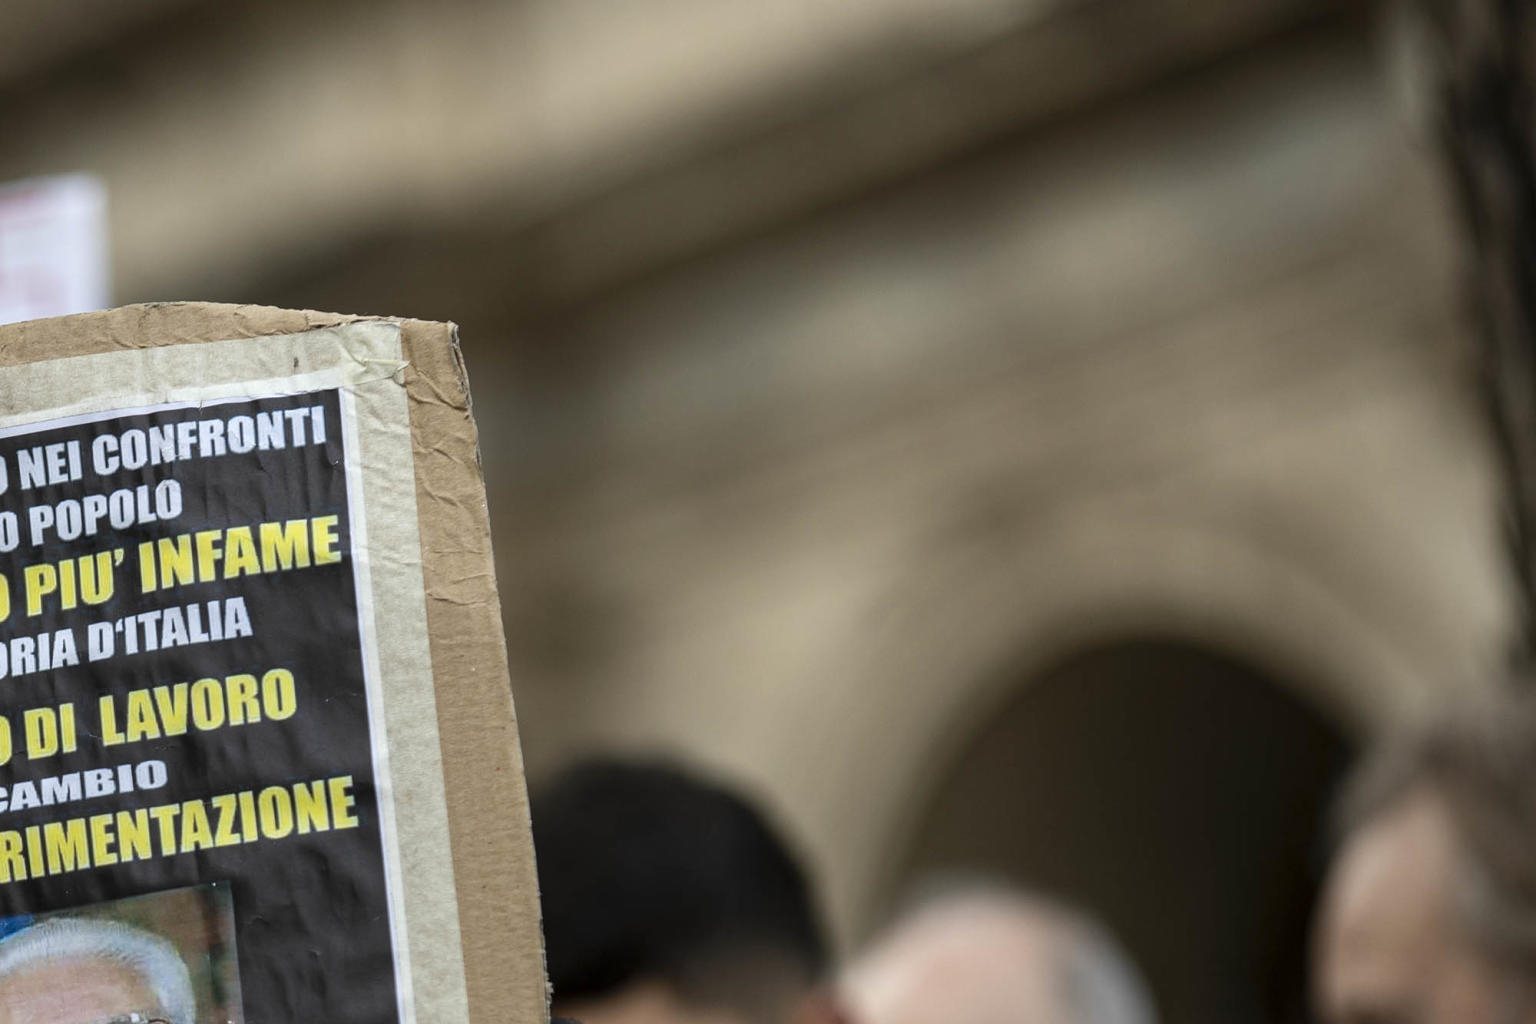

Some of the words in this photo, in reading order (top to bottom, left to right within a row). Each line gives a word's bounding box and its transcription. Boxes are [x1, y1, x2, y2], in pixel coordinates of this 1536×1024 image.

[16, 440, 83, 491] NEI
[91, 404, 327, 476] CONFRONTI
[28, 478, 183, 547] POPOLO
[23, 547, 125, 618] PIU'
[138, 514, 342, 595] INFAME
[23, 702, 78, 761] DI
[99, 667, 298, 748] LAVORO
